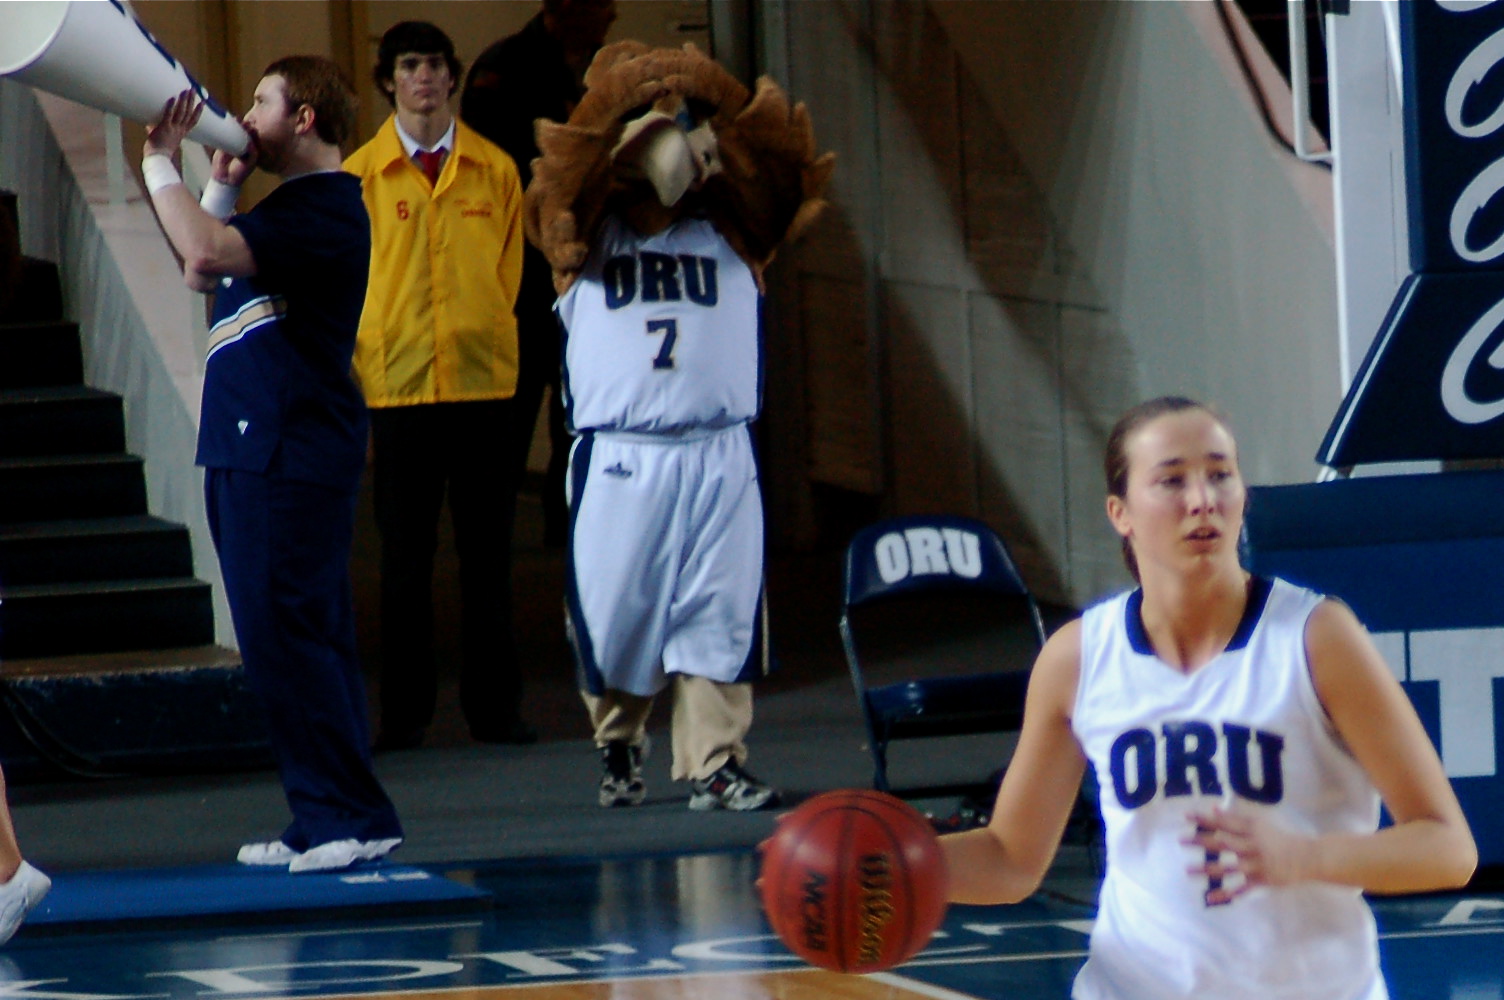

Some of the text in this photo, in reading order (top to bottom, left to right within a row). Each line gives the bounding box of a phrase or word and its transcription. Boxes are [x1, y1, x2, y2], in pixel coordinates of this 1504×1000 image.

[603, 252, 718, 310] ORU
[647, 318, 677, 371] 7
[874, 526, 983, 584] ORU
[1109, 719, 1285, 810] ORU
